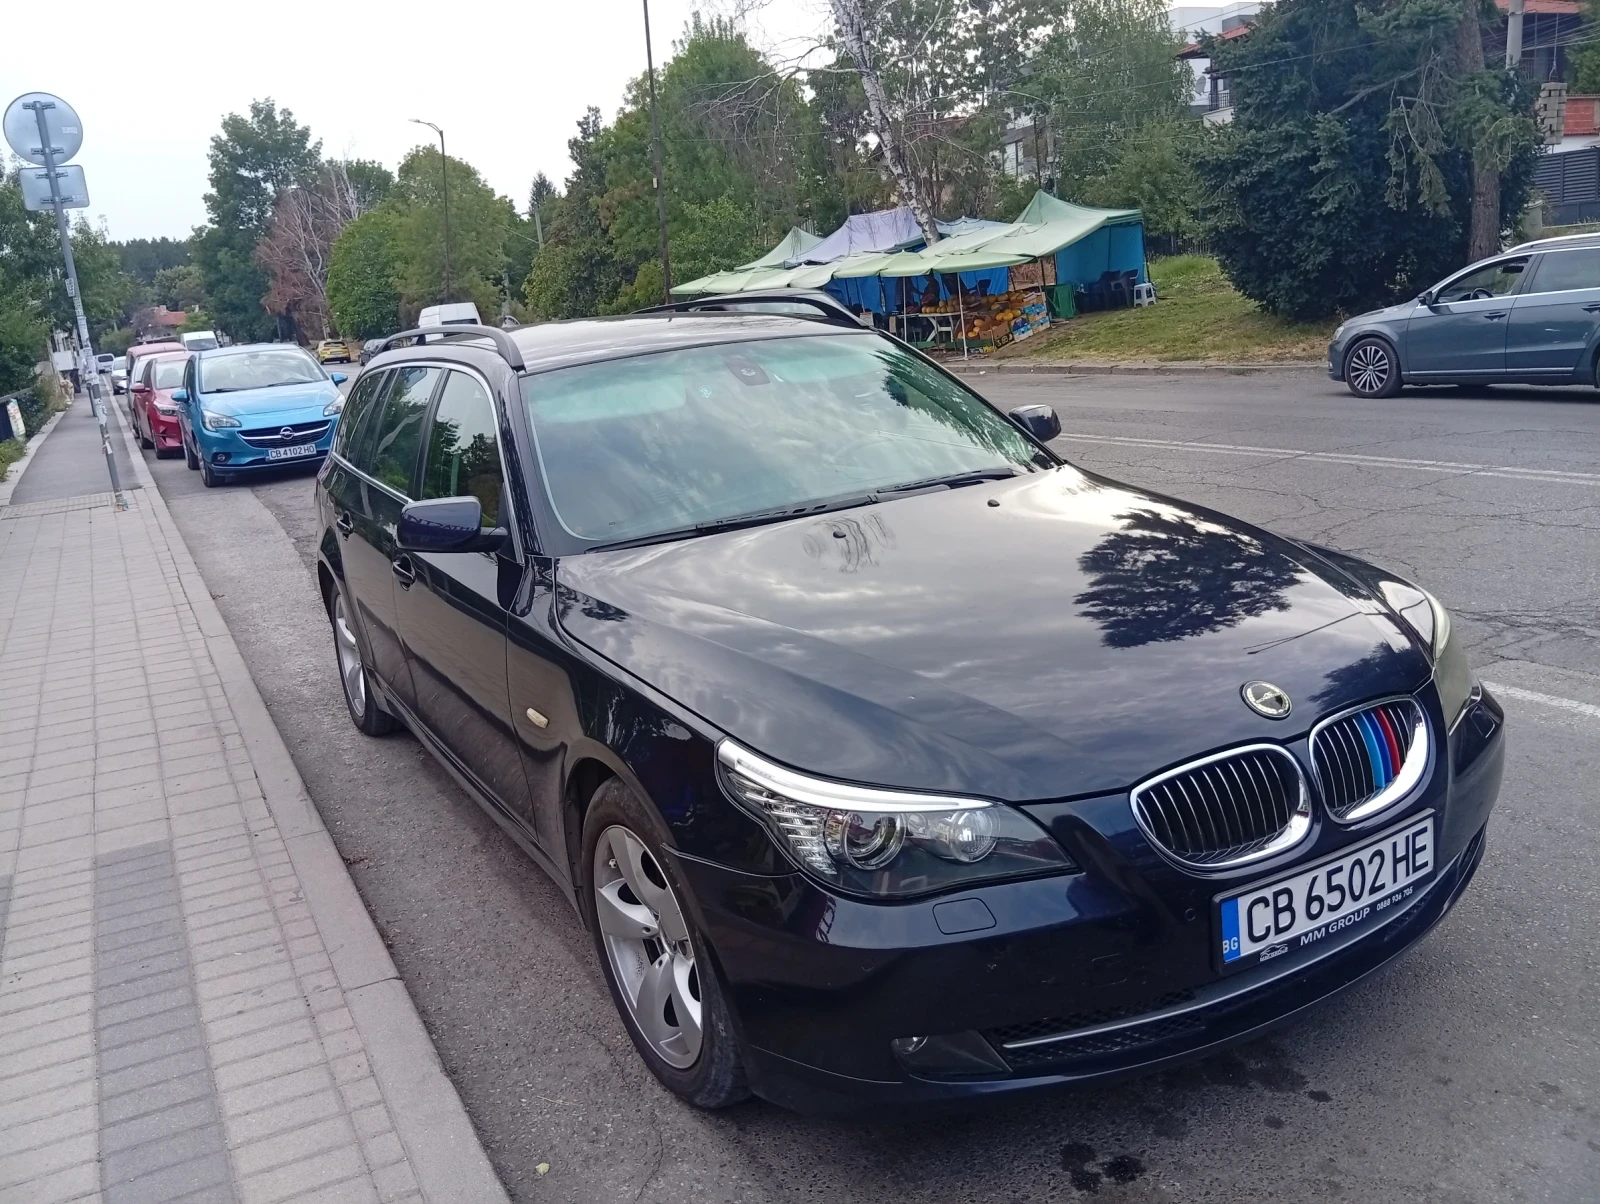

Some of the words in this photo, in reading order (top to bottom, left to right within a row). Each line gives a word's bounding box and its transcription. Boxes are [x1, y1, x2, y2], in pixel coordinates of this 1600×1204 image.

[270, 450, 282, 459] CB
[283, 446, 303, 457] 4102
[1247, 886, 1296, 943] CB
[1305, 849, 1386, 921] 6502
[1392, 826, 1429, 886] HE
[1376, 898, 1391, 912] 0888
[1300, 927, 1326, 946] MM
[1328, 907, 1371, 934] GROUP
[1223, 937, 1239, 954] BG
